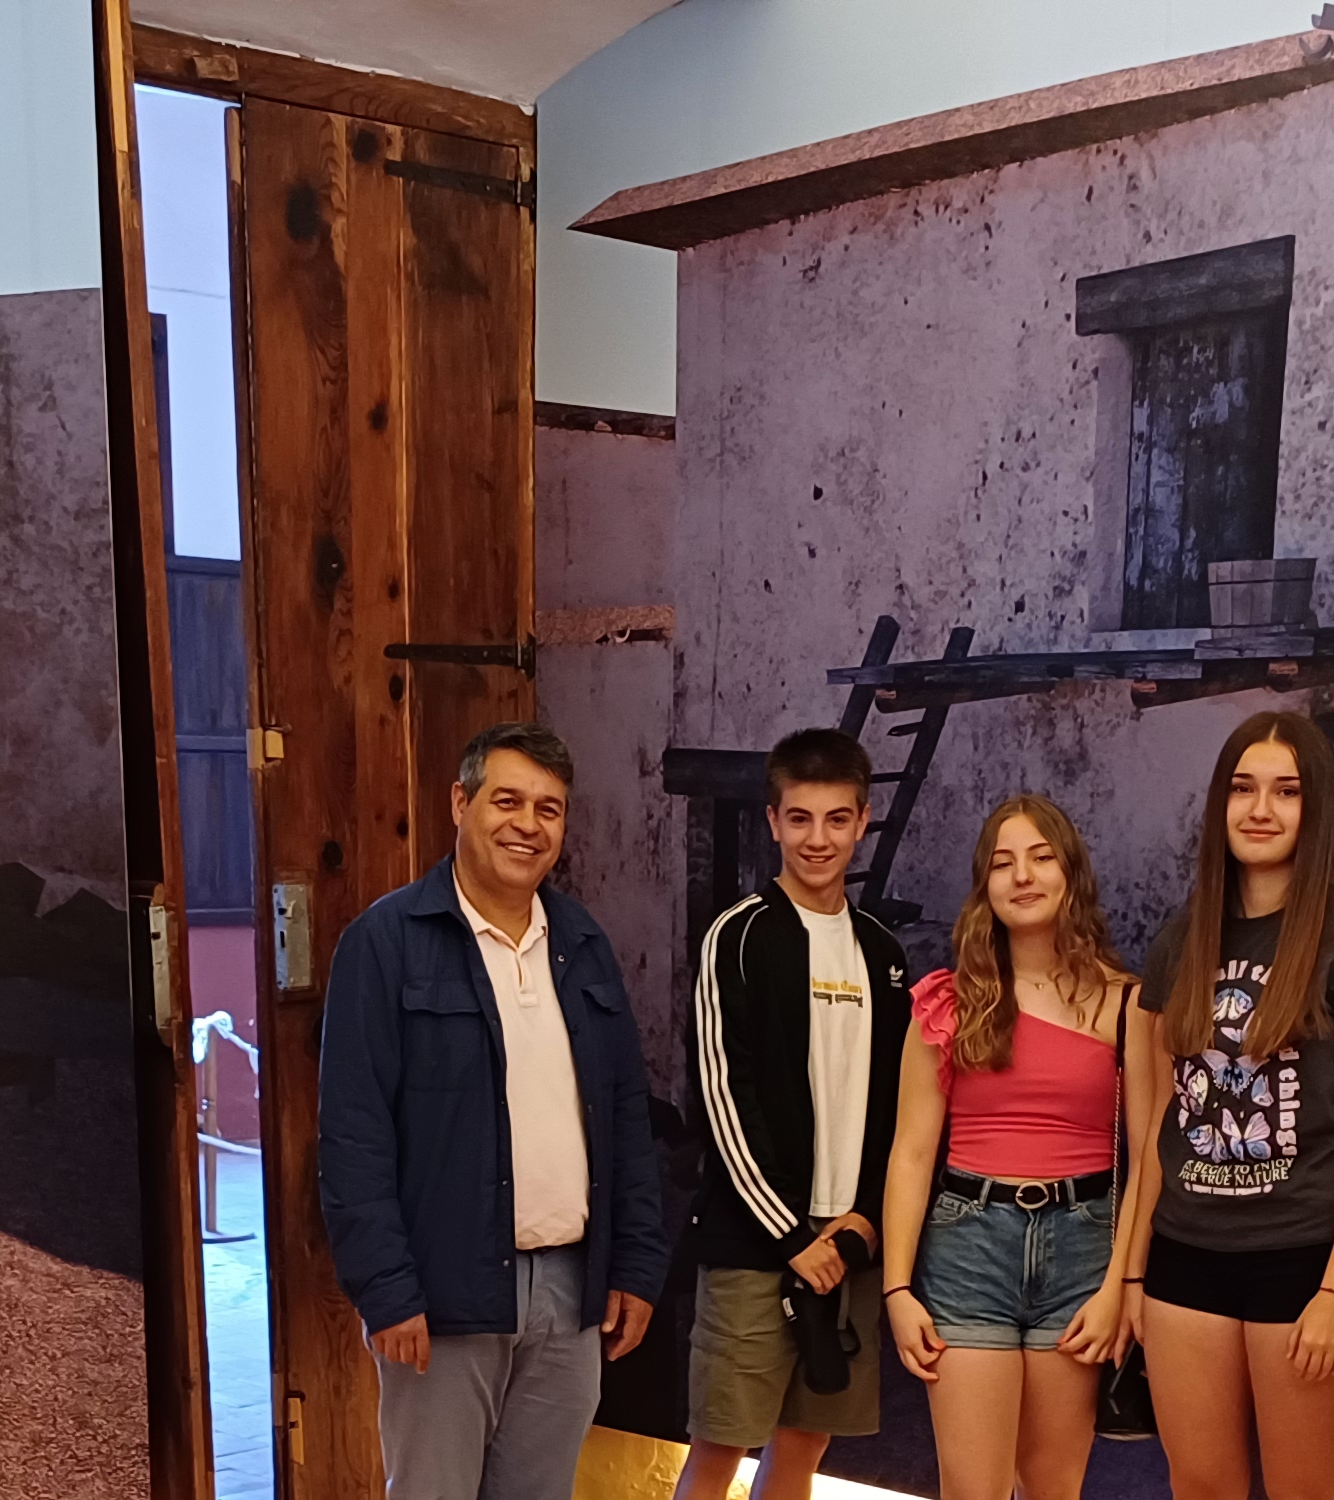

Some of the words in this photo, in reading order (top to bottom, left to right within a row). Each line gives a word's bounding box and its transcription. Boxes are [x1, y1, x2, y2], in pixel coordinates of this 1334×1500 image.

[1194, 1160, 1232, 1175] BEGIN
[1234, 1164, 1251, 1175] TO
[1200, 1173, 1233, 1186] TRUE
[1235, 1167, 1290, 1187] NATURE
